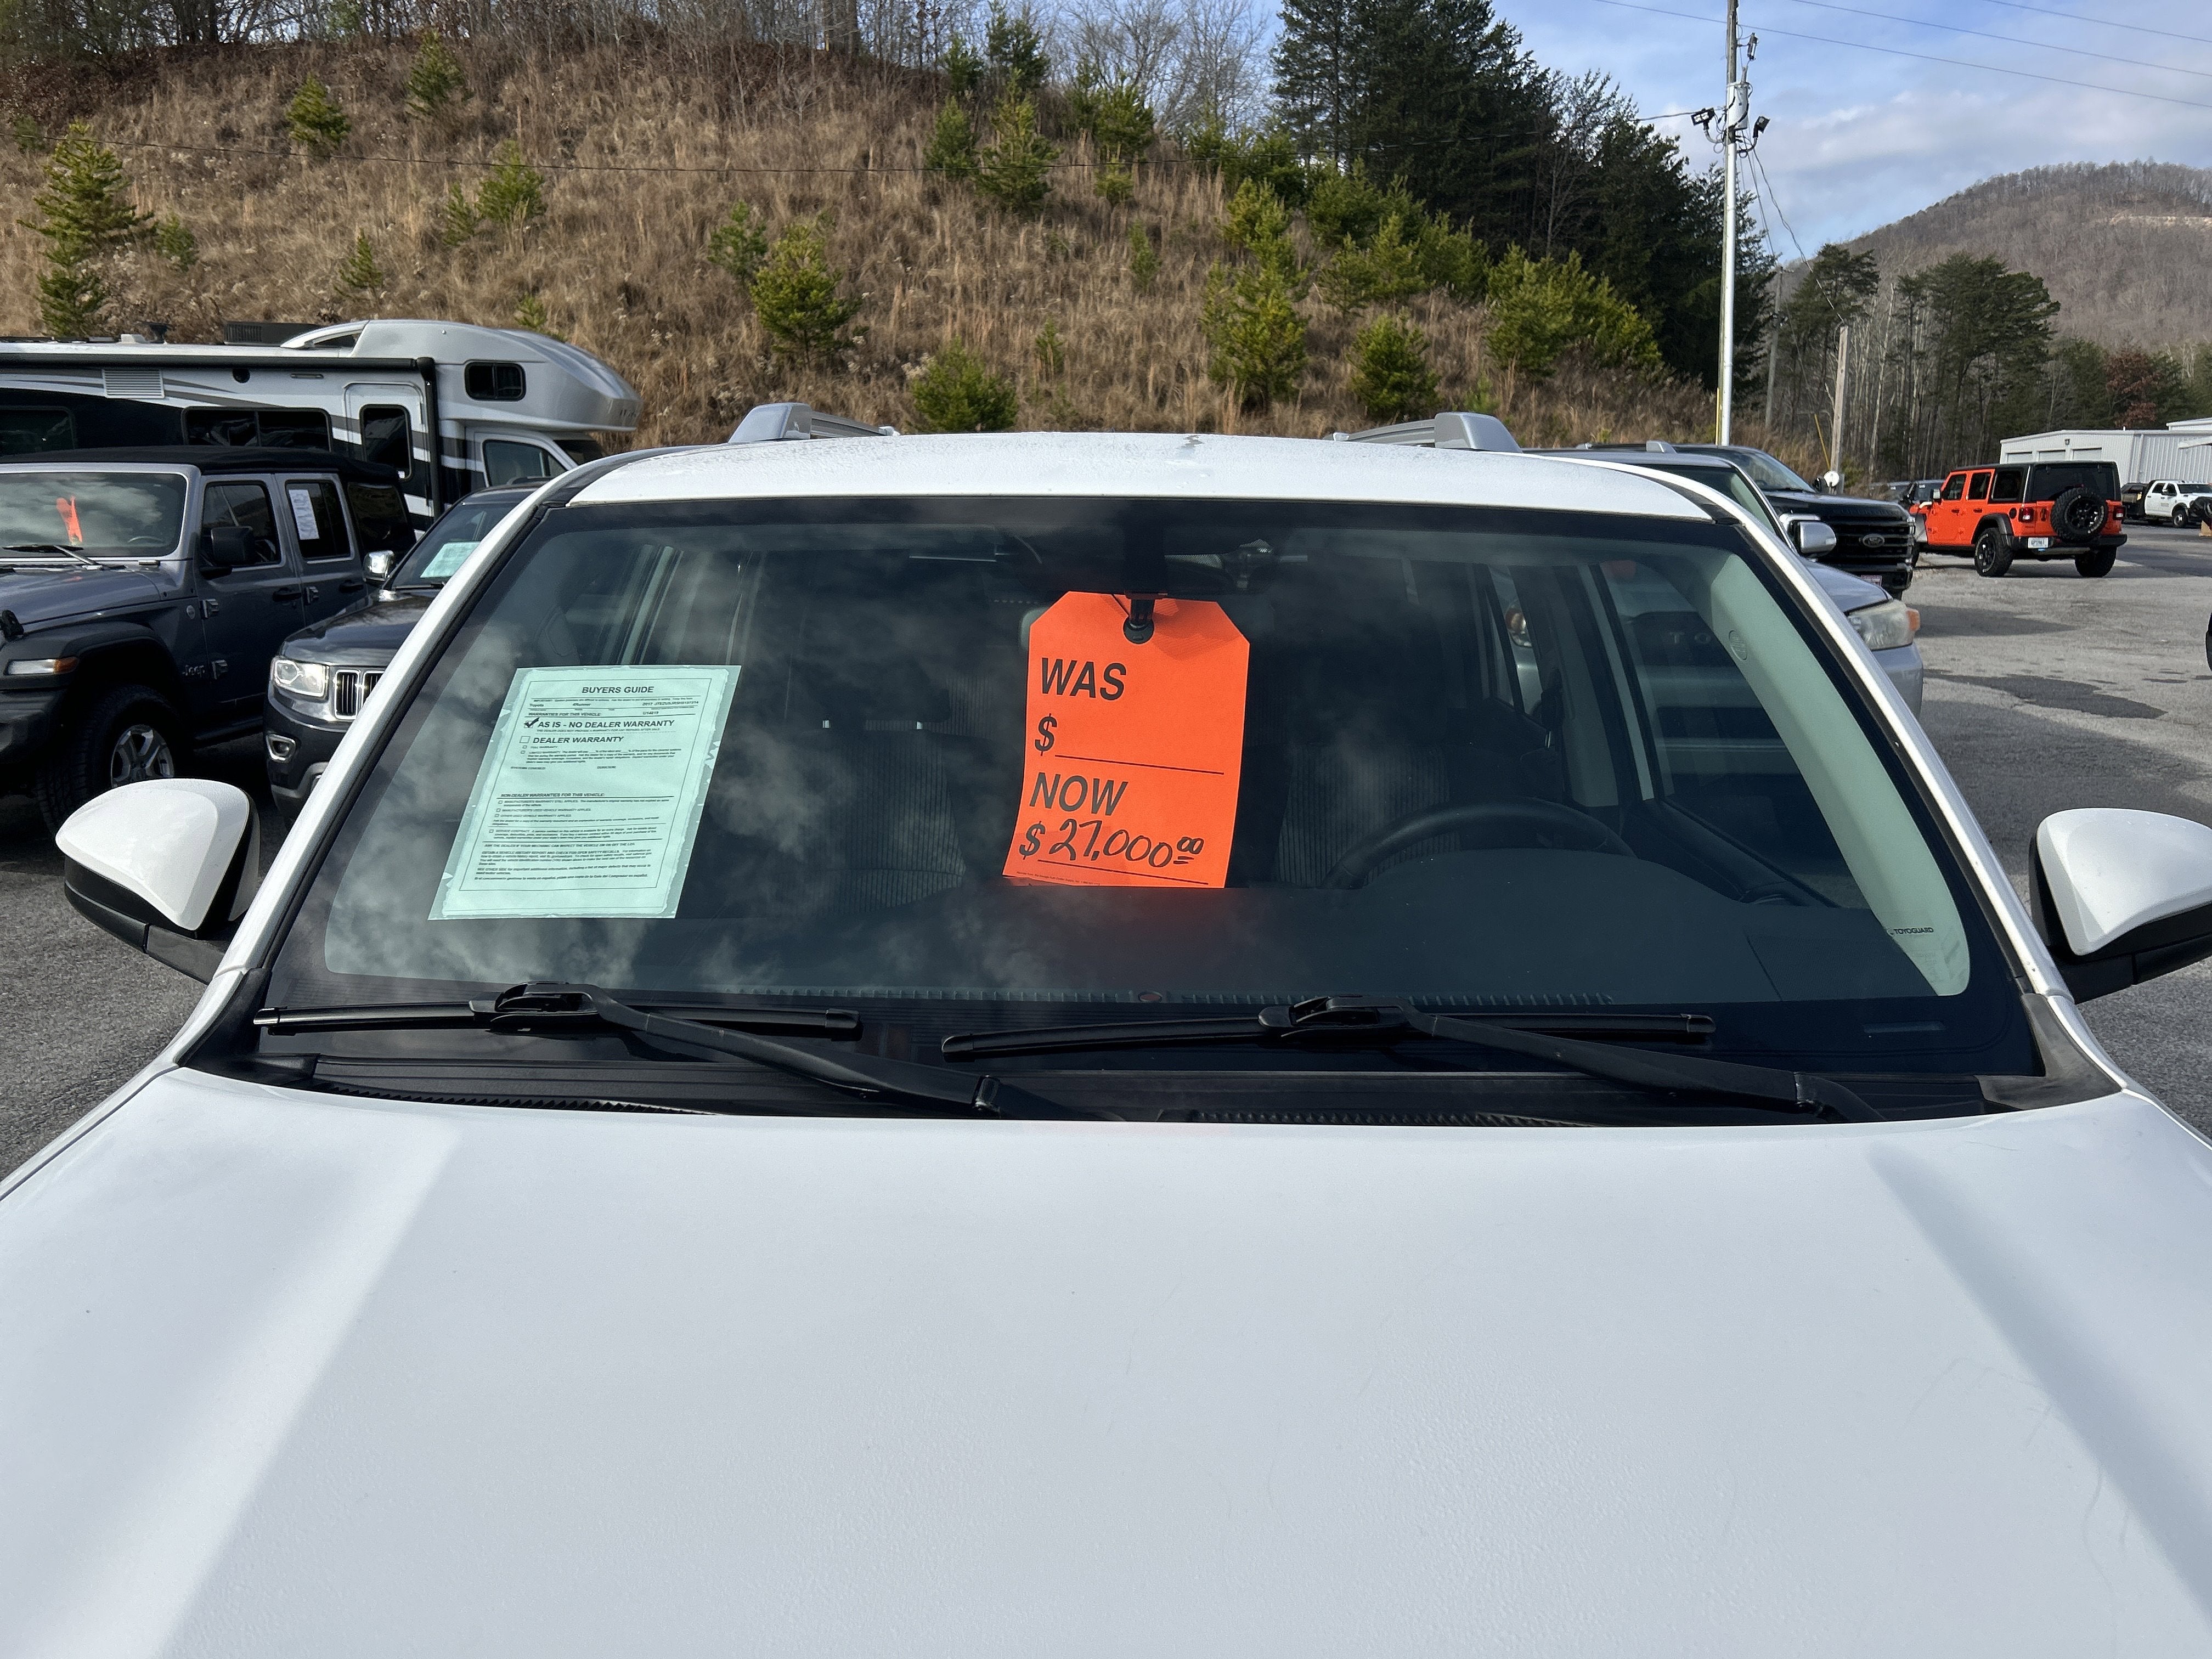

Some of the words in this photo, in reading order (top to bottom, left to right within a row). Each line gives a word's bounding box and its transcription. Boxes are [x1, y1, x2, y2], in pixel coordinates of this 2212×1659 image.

[1040, 657, 1127, 701] WAS
[1035, 713, 1057, 757] $
[1029, 772, 1128, 816] NOW
[1019, 821, 1046, 860] $
